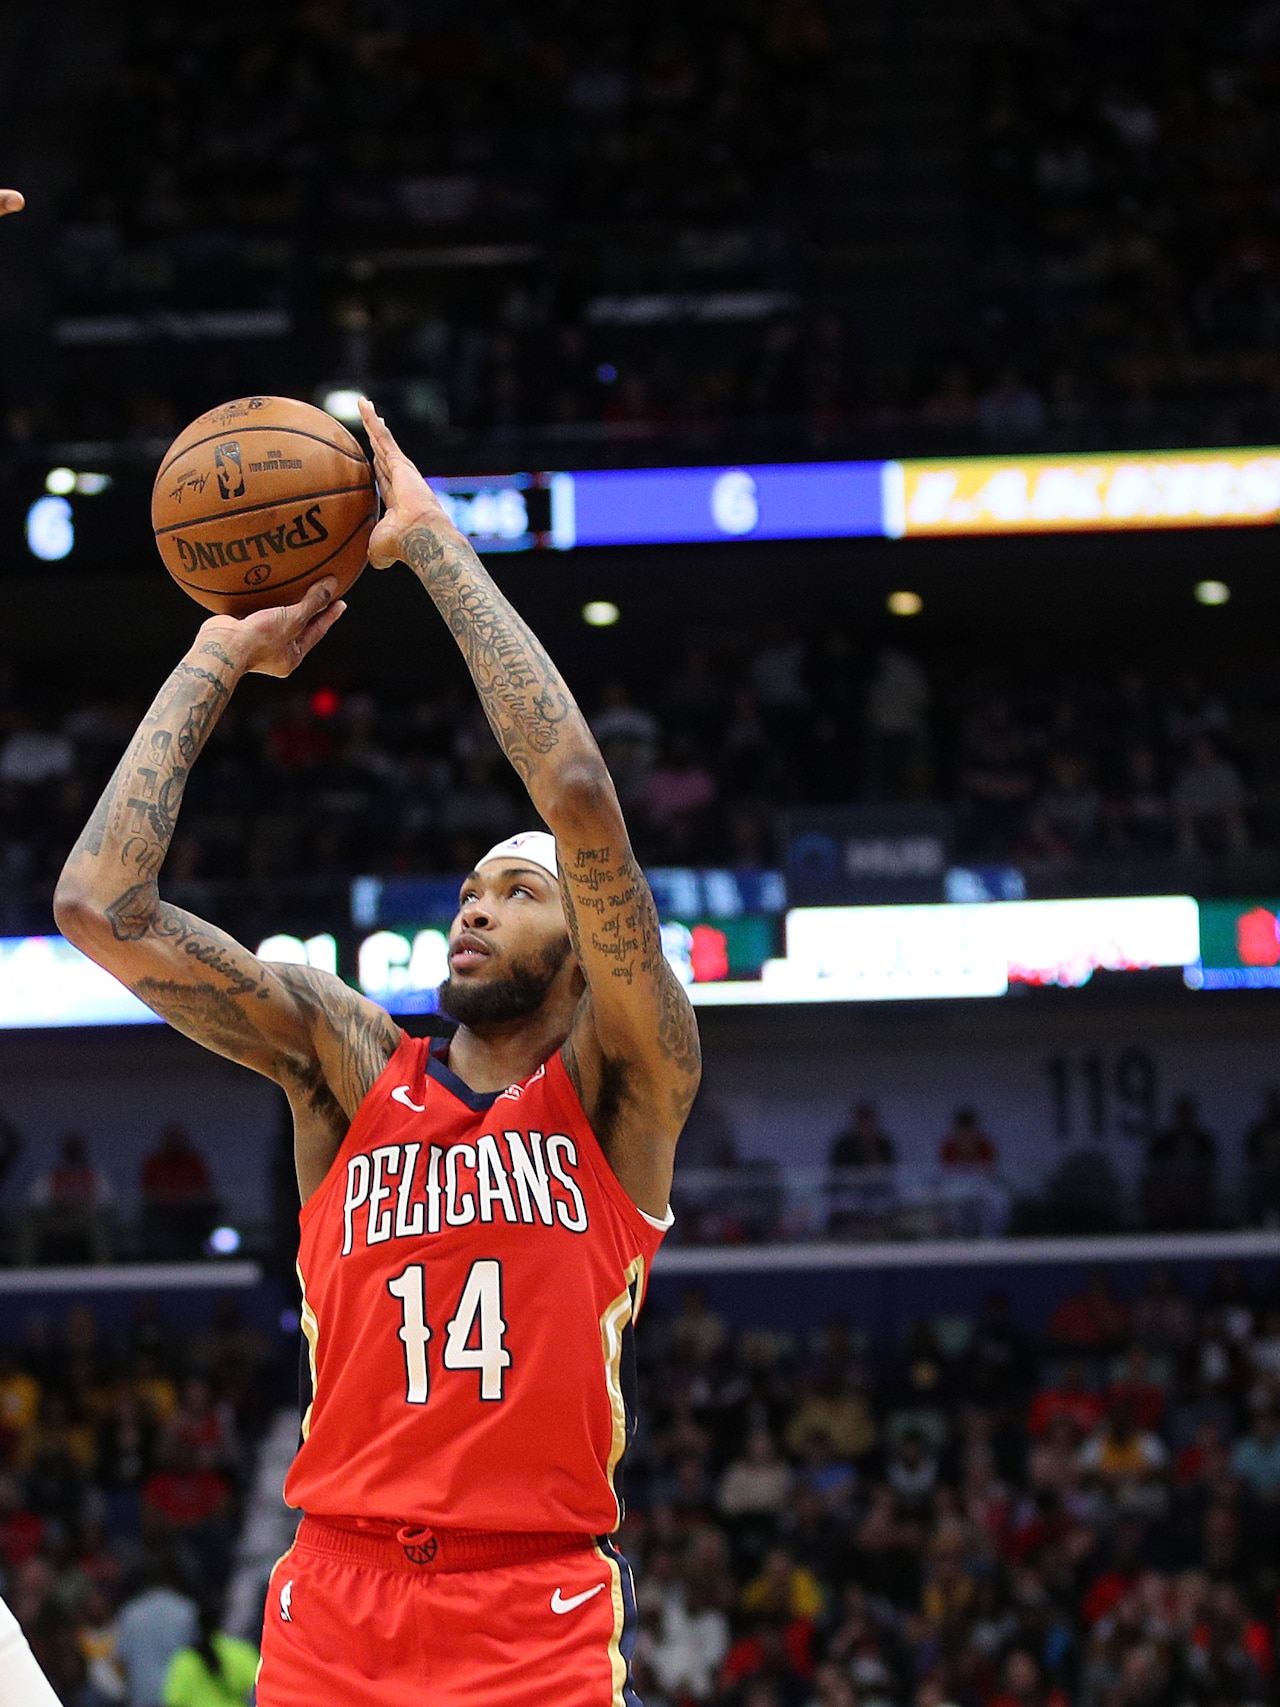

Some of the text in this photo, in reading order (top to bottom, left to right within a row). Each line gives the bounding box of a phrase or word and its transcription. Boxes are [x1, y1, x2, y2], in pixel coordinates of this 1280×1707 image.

[26, 495, 75, 562] 6
[710, 470, 760, 535] 6
[172, 504, 329, 573] SPALDING
[341, 1130, 589, 1257] PELICANS
[387, 1258, 511, 1405] 14
